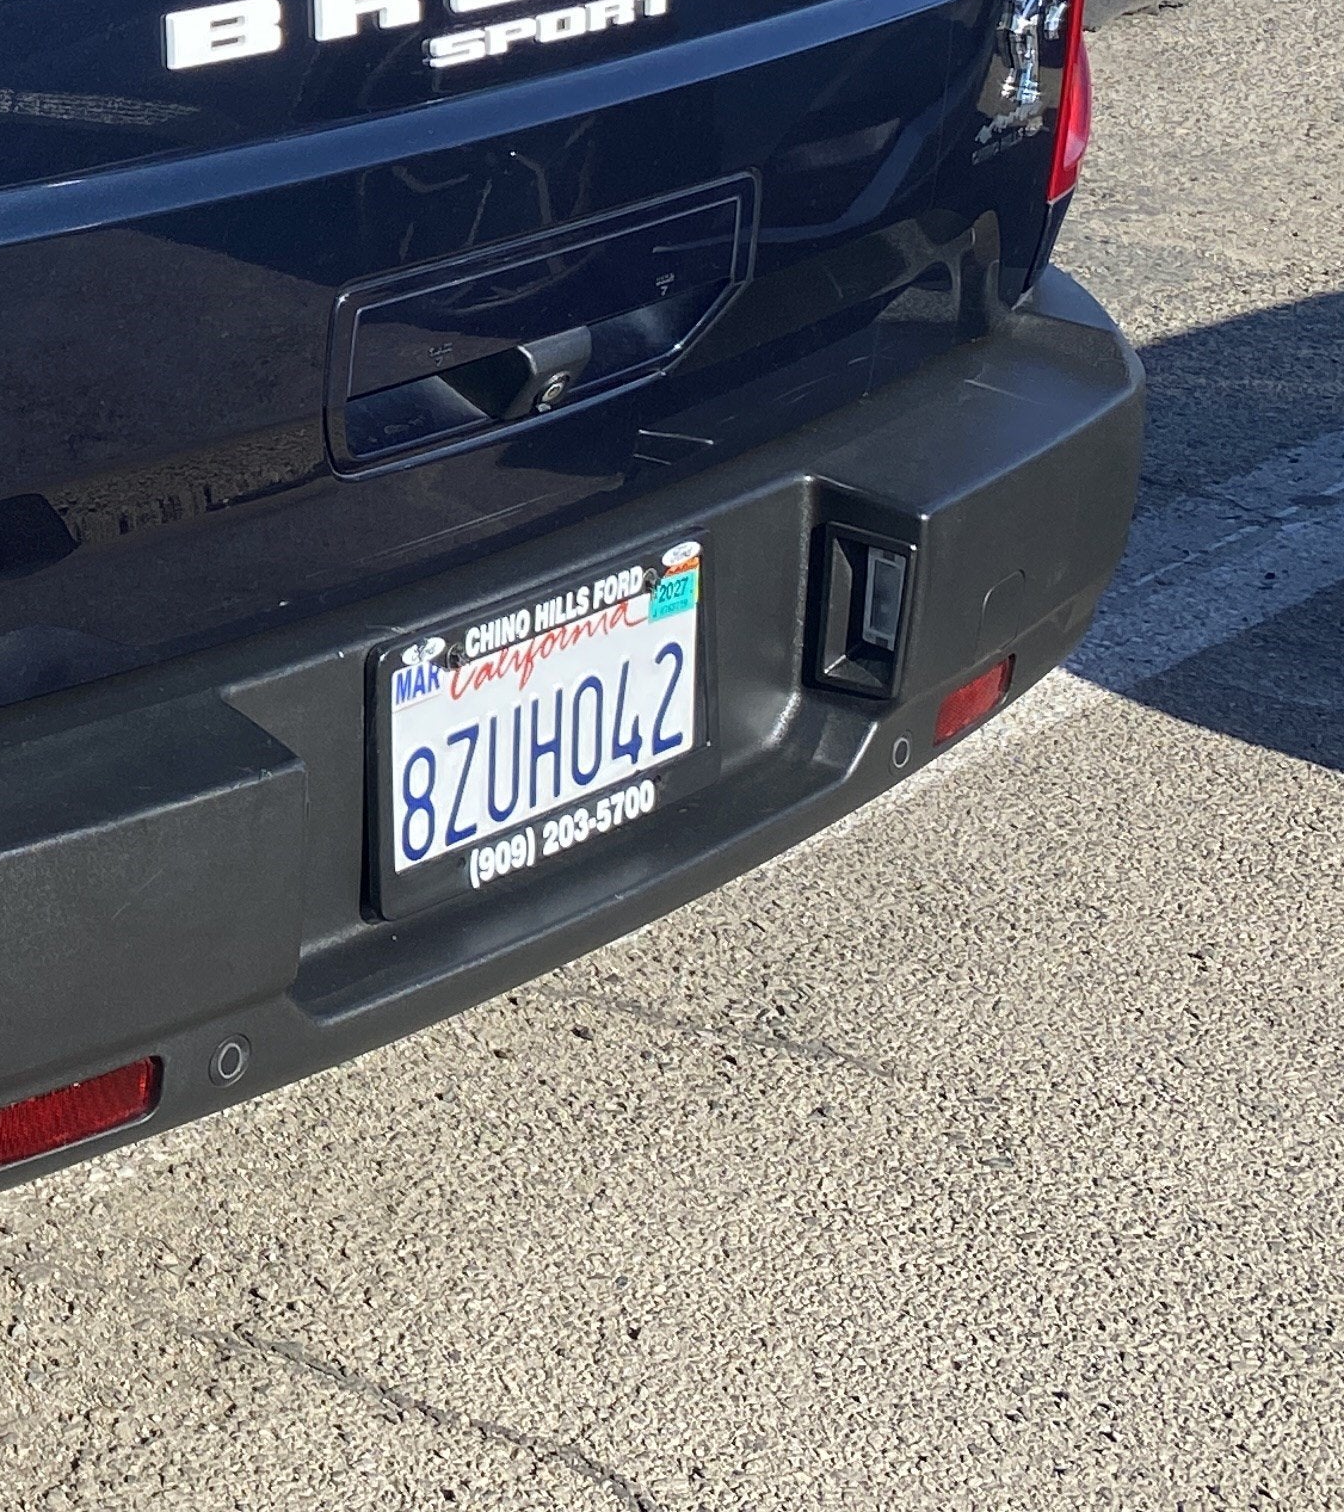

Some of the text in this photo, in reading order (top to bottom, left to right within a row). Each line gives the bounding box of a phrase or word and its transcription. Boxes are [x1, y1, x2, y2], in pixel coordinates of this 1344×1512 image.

[465, 617, 531, 658] CHINO
[534, 587, 591, 633] HILLS
[592, 565, 644, 610] FORD
[658, 577, 689, 603] 2027
[395, 661, 440, 705] MAR
[450, 601, 650, 701] California
[401, 641, 683, 862] 8ZUH042
[469, 780, 657, 889] (909) 203-5700
